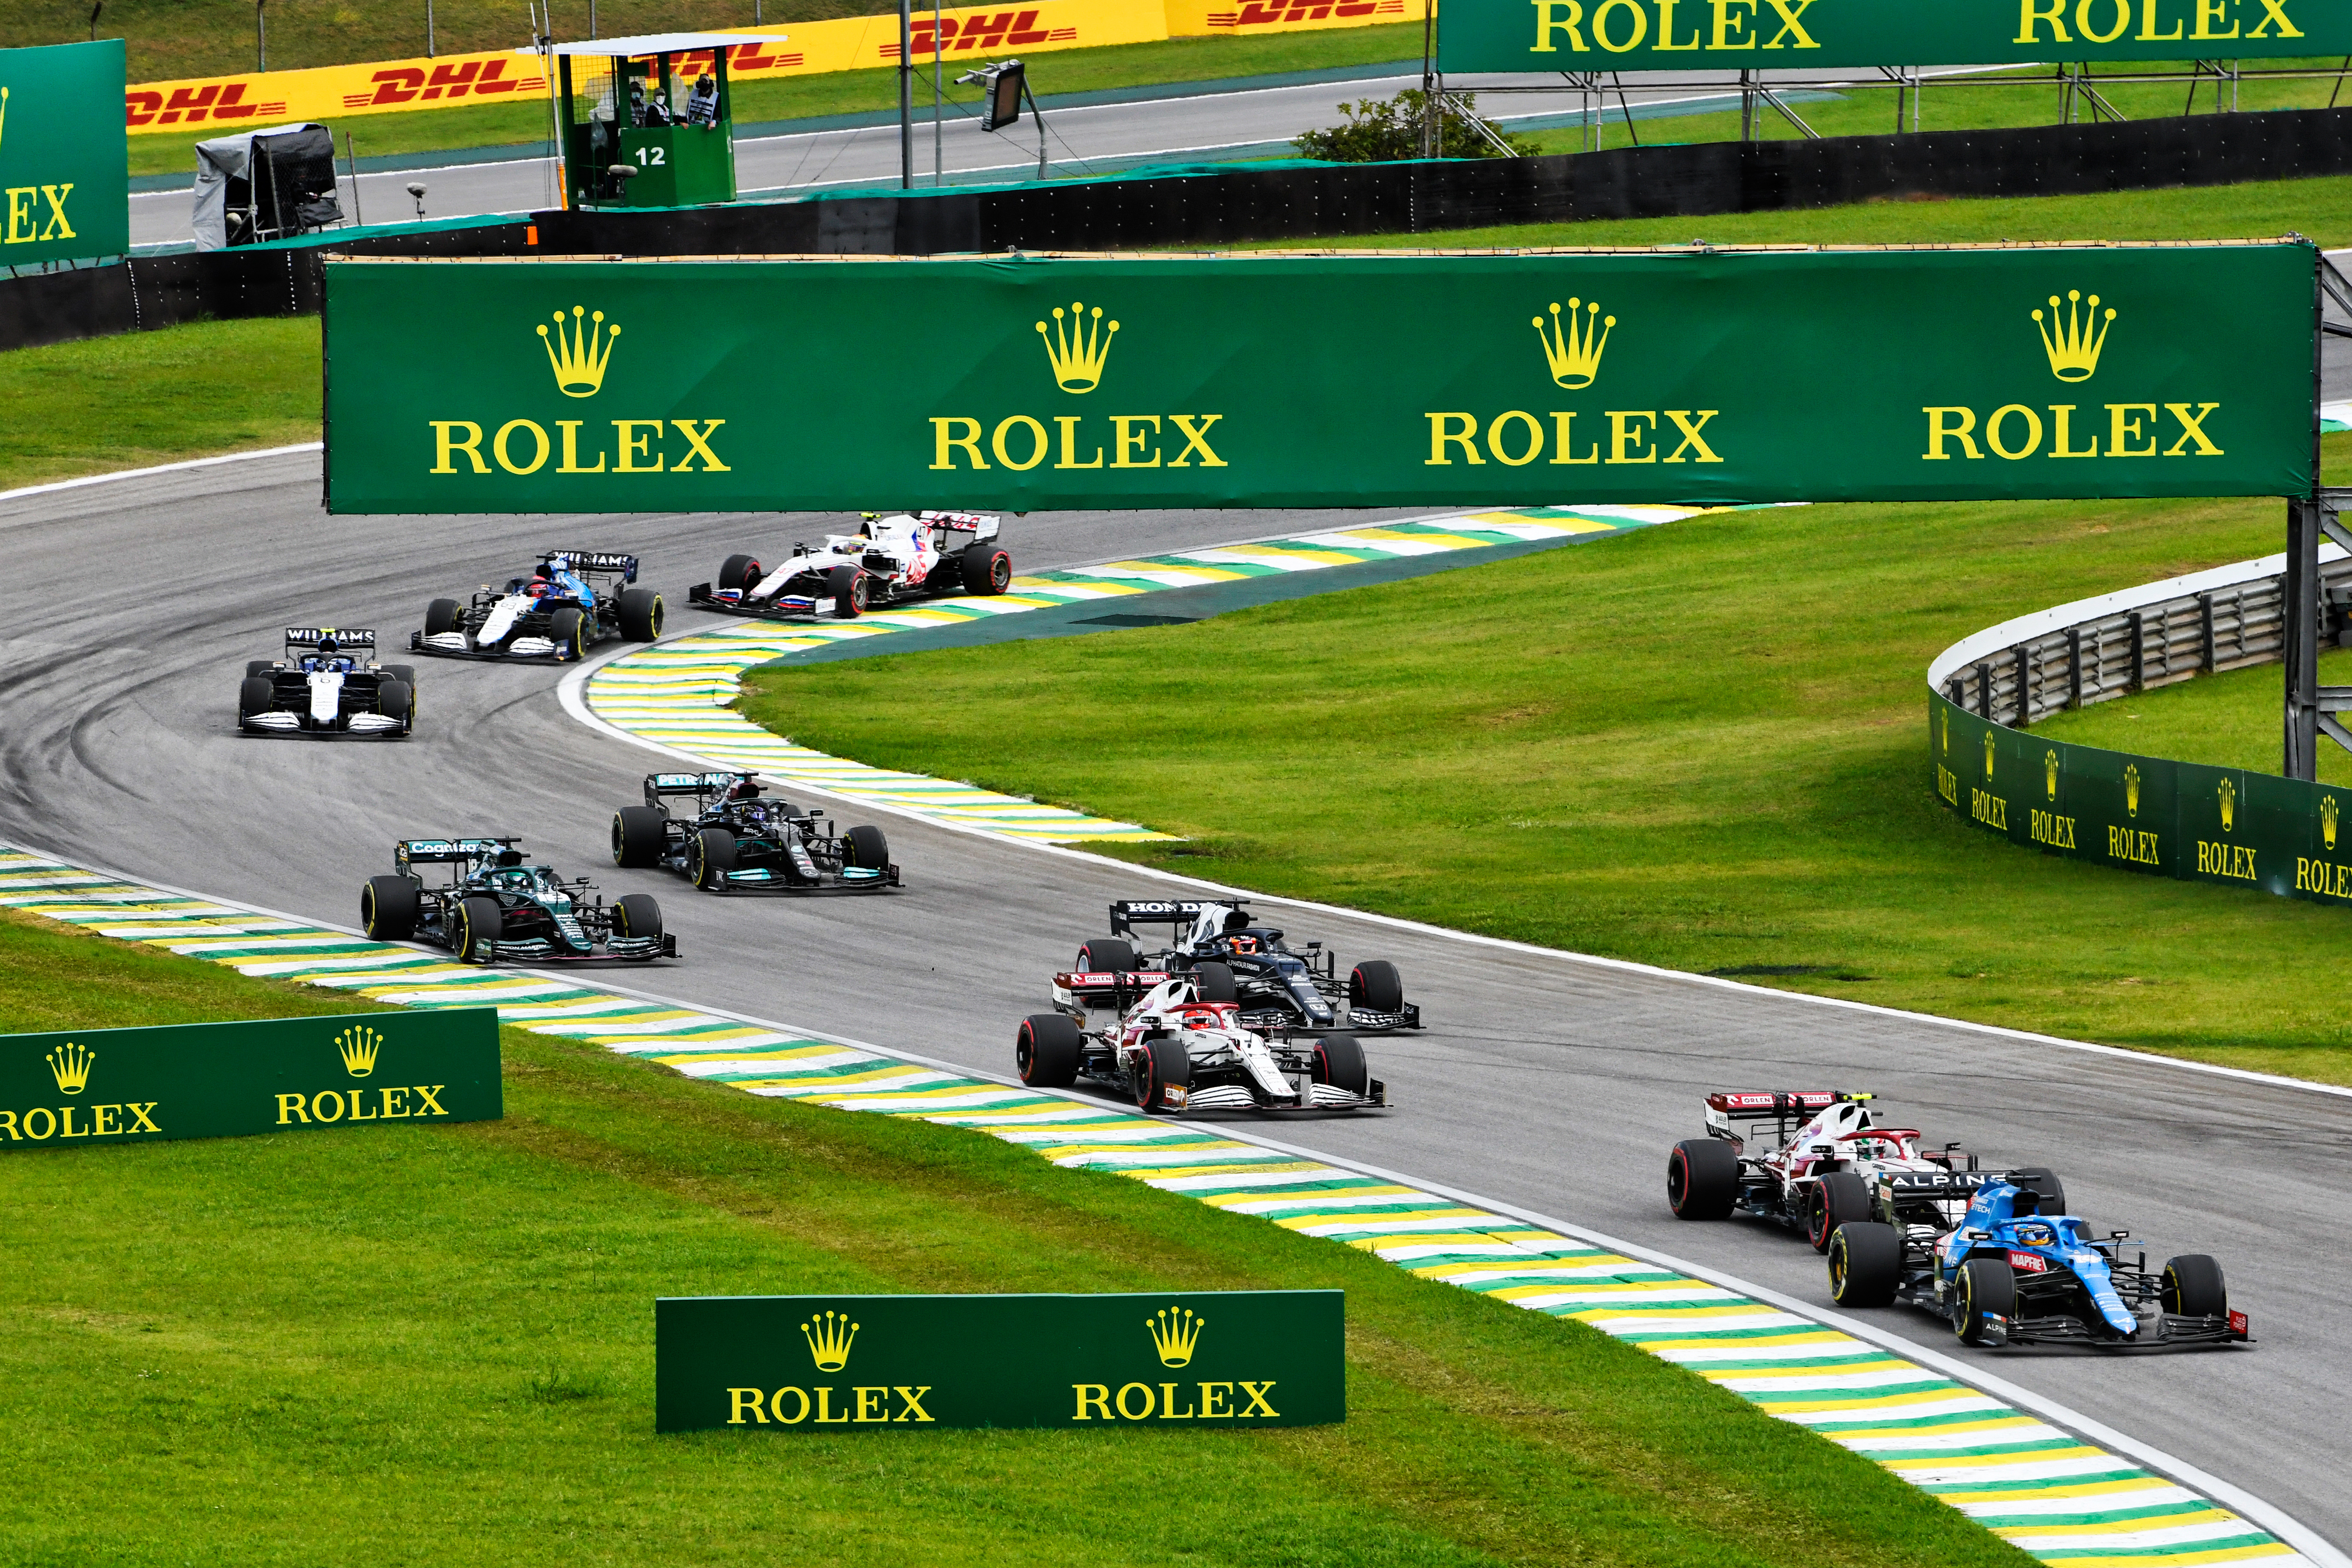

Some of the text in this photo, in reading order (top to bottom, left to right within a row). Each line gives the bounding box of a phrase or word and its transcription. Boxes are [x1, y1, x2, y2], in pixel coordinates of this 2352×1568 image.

[910, 10, 1049, 55] DHL
[1529, 0, 1821, 53] ROLEX
[2012, 0, 2304, 44] ROLEX
[371, 59, 518, 105] DHL
[632, 42, 776, 80] HL
[126, 83, 257, 127] DHL
[635, 147, 666, 166] 12
[0, 182, 76, 244] EX
[429, 418, 731, 475] ROLEX
[928, 414, 1228, 471] ROLEX
[1424, 409, 1724, 466] ROLEX
[1921, 402, 2225, 461] ROLEX
[1937, 763, 1958, 806] ROLEX
[1971, 787, 2008, 831] ROLEX
[2031, 808, 2076, 849] ROLEX
[412, 842, 478, 857] Cogniza
[2108, 825, 2160, 865] ROLEX
[2197, 840, 2257, 881] ROLEX
[2295, 857, 2352, 899] ROLE
[0, 1101, 162, 1142] ROLEX
[275, 1084, 449, 1125] ROLEX
[2011, 1253, 2043, 1271] MAPFRE
[1985, 1323, 2007, 1336] ALPINE
[726, 1386, 936, 1425] ROLEX
[1072, 1381, 1280, 1421] ROLEX
